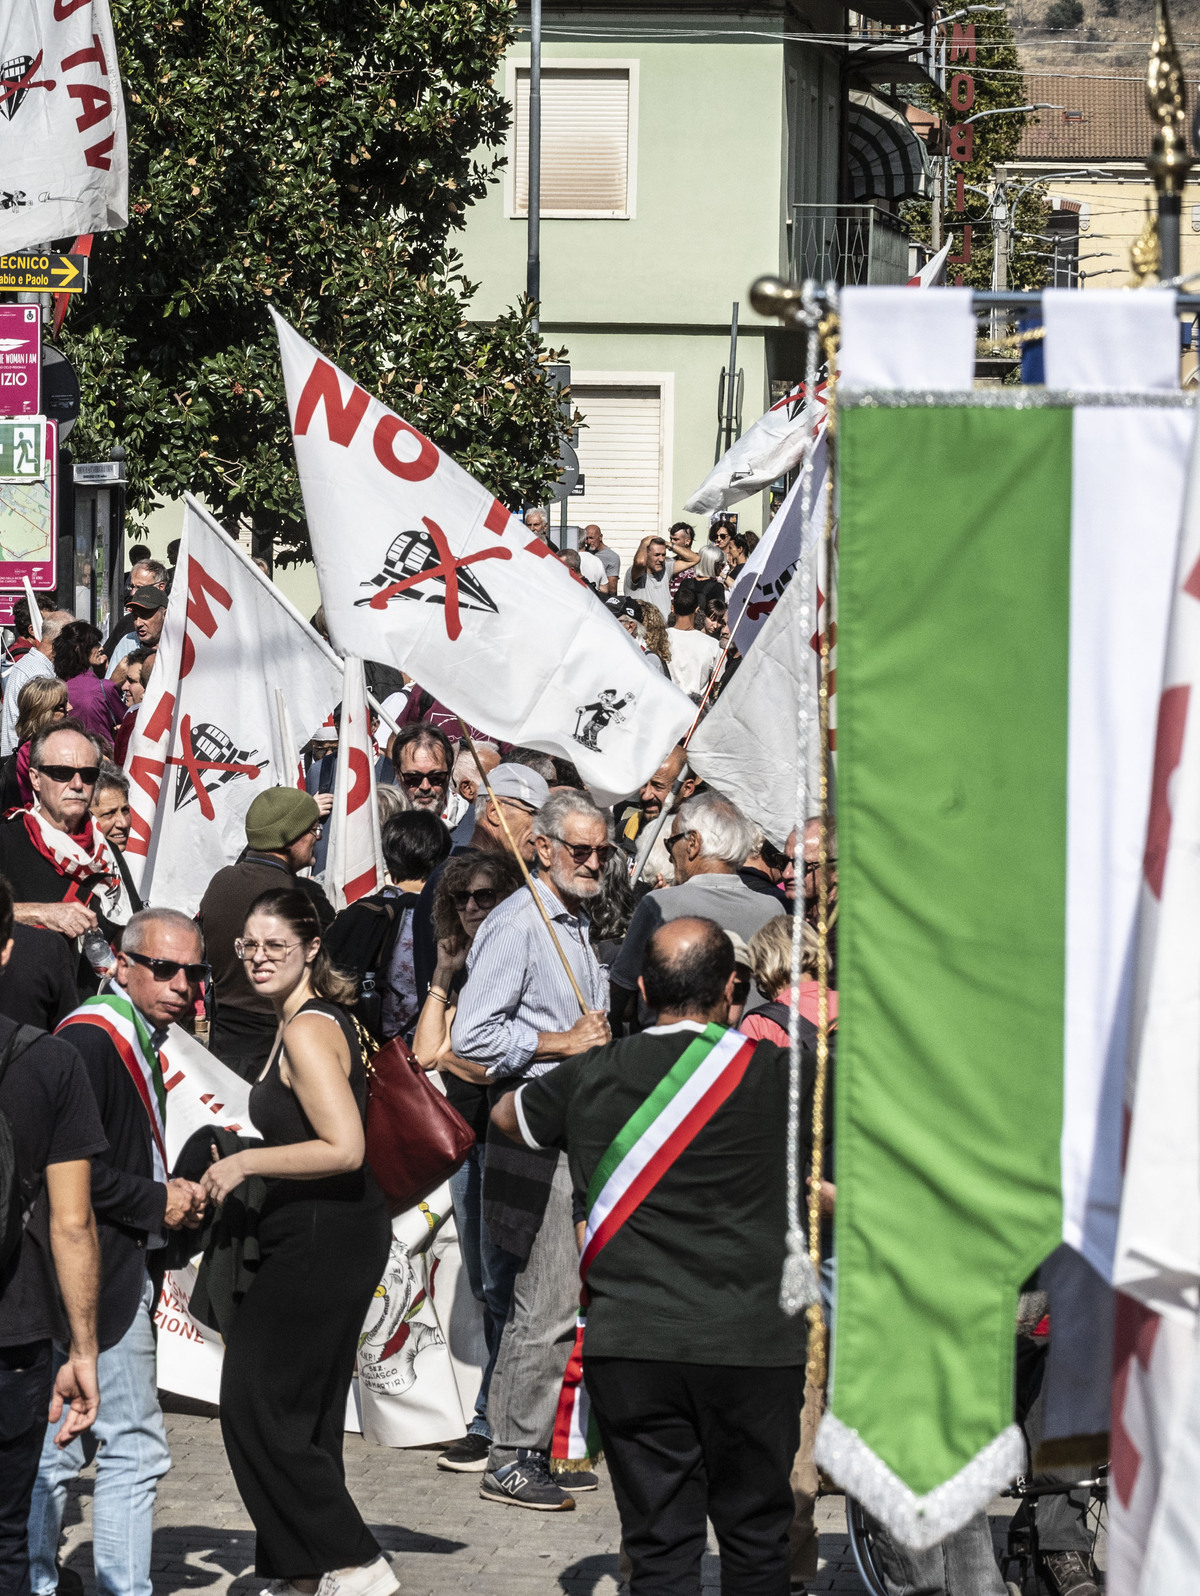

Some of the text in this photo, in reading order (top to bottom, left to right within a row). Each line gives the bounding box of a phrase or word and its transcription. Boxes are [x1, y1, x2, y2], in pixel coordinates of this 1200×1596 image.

[60, 34, 115, 171] TAV
[18, 275, 23, 284] e
[25, 273, 49, 285] Paolo
[6, 354, 24, 364] WOMAN
[29, 354, 37, 364] AM
[294, 358, 441, 482] NO
[501, 1470, 528, 1494] N
